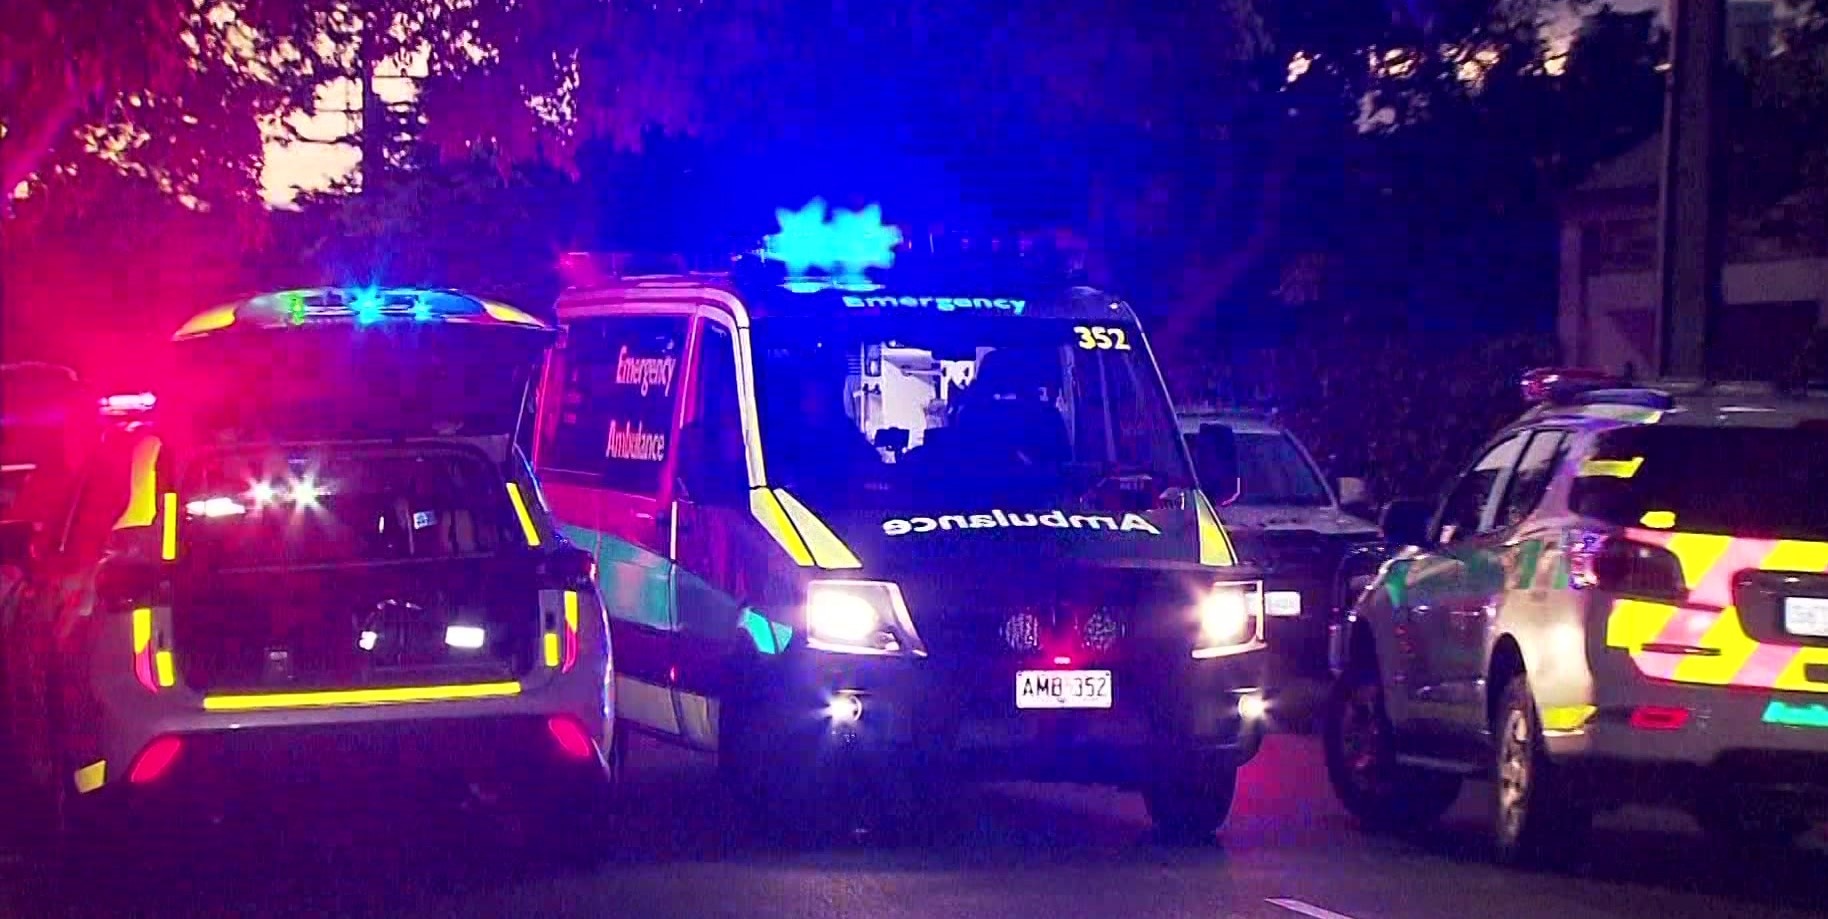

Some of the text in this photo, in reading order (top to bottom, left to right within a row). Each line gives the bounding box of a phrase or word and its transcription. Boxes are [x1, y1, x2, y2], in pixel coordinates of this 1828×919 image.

[841, 295, 1027, 315] Emergency
[1072, 325, 1131, 350] 352
[616, 345, 676, 397] Emergency
[605, 418, 665, 461] Ambulance
[1022, 676, 1108, 698] AMB 352
